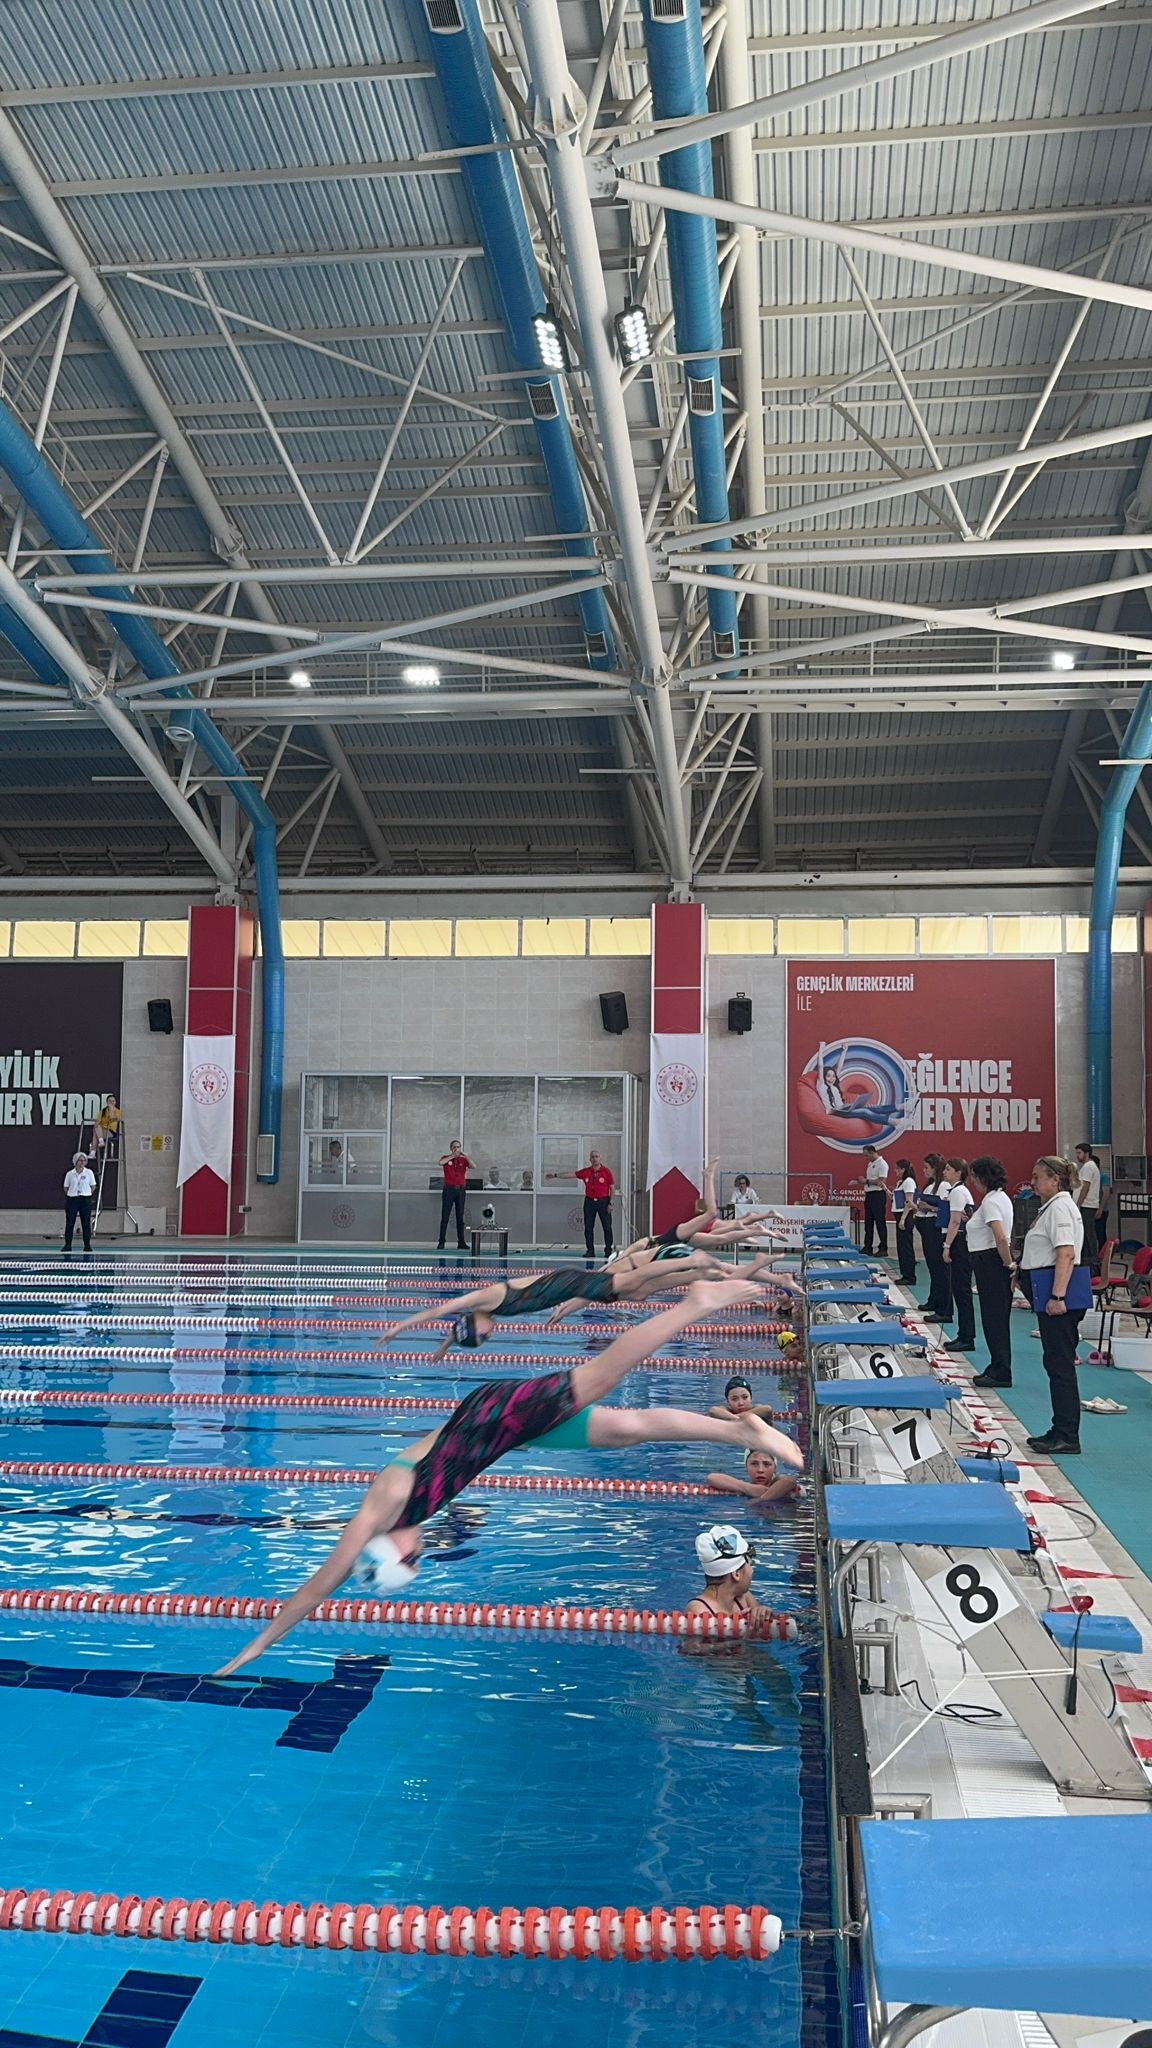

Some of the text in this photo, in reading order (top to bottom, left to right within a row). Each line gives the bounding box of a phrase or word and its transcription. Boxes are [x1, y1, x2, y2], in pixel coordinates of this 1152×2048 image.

[797, 974, 914, 993] GENÇLİK MERKEZLERİ
[797, 996, 812, 1011] İLE
[0, 1093, 33, 1125] ER
[960, 1098, 1041, 1132] YERDE
[869, 1352, 894, 1379] 6
[892, 1417, 921, 1462] 7
[945, 1563, 999, 1624] 8
